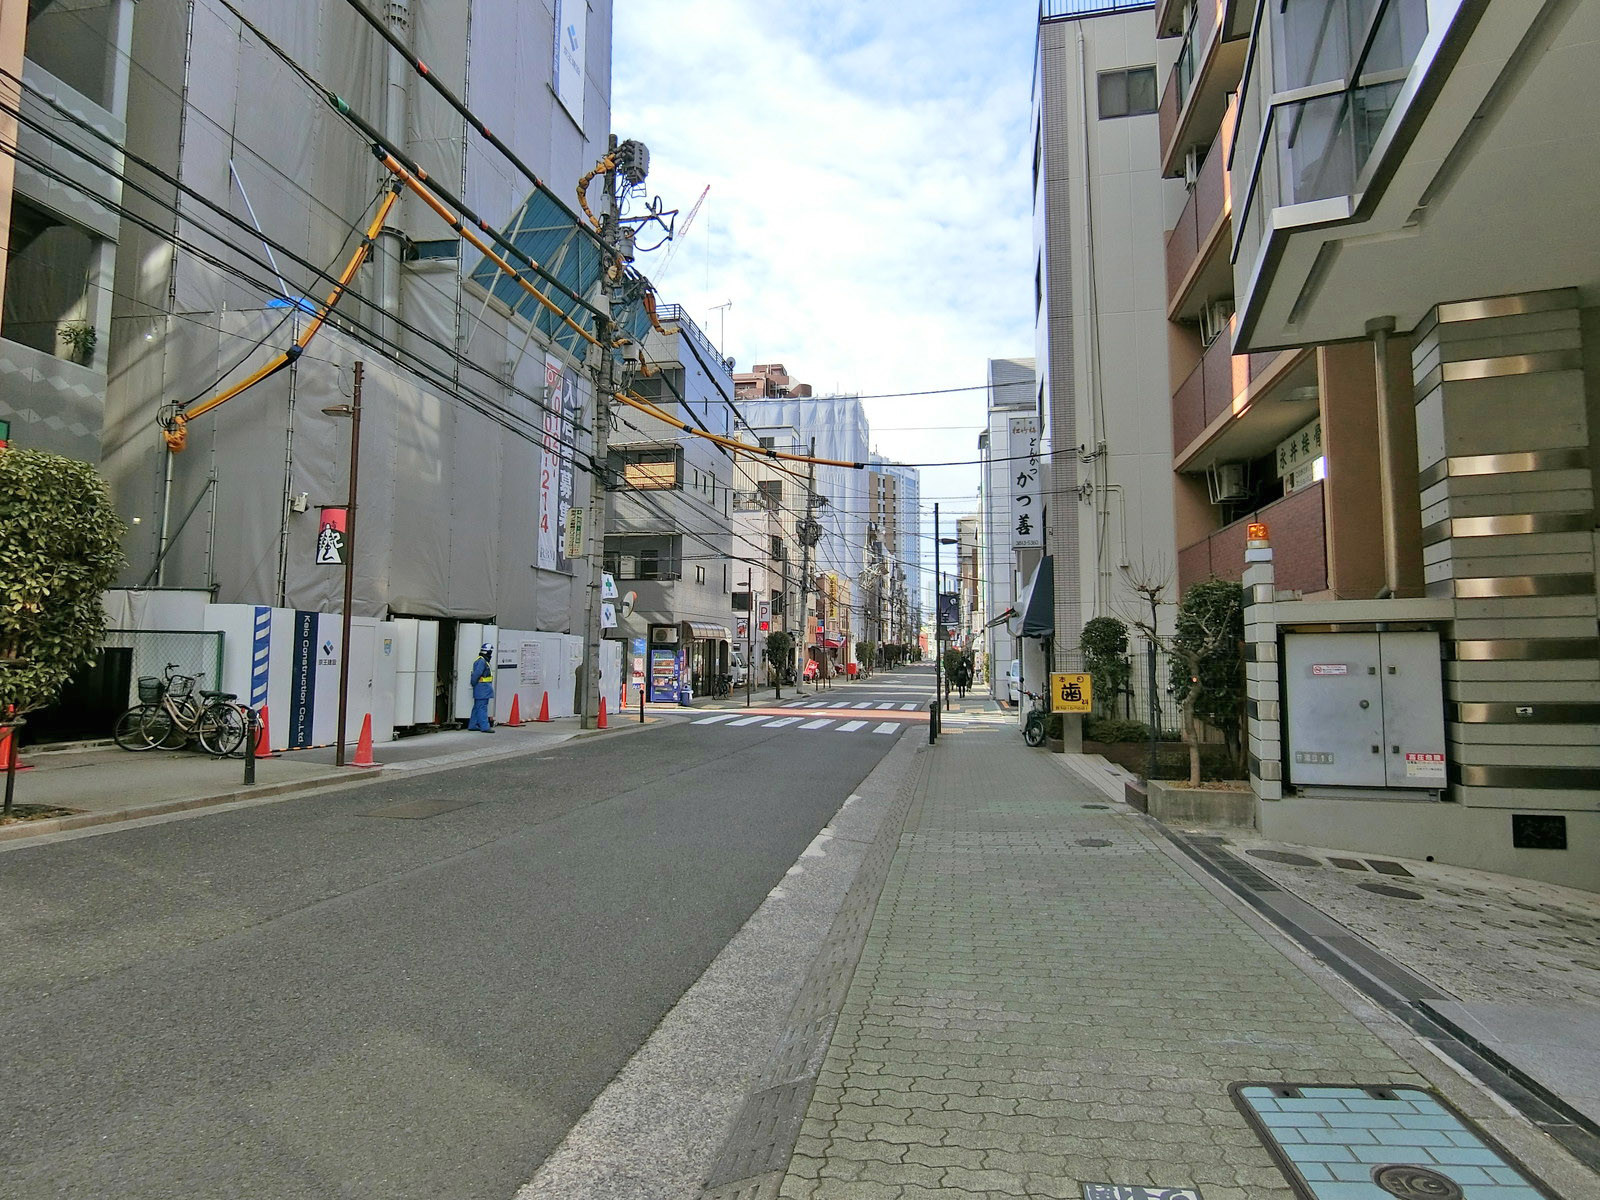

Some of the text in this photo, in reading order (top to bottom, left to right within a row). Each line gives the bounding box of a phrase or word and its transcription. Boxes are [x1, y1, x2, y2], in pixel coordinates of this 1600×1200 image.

[1029, 437, 1039, 475] とんかつ
[1015, 471, 1034, 536] かつ善
[303, 615, 311, 638] Keio
[760, 606, 768, 618] P
[299, 640, 310, 705] Construction
